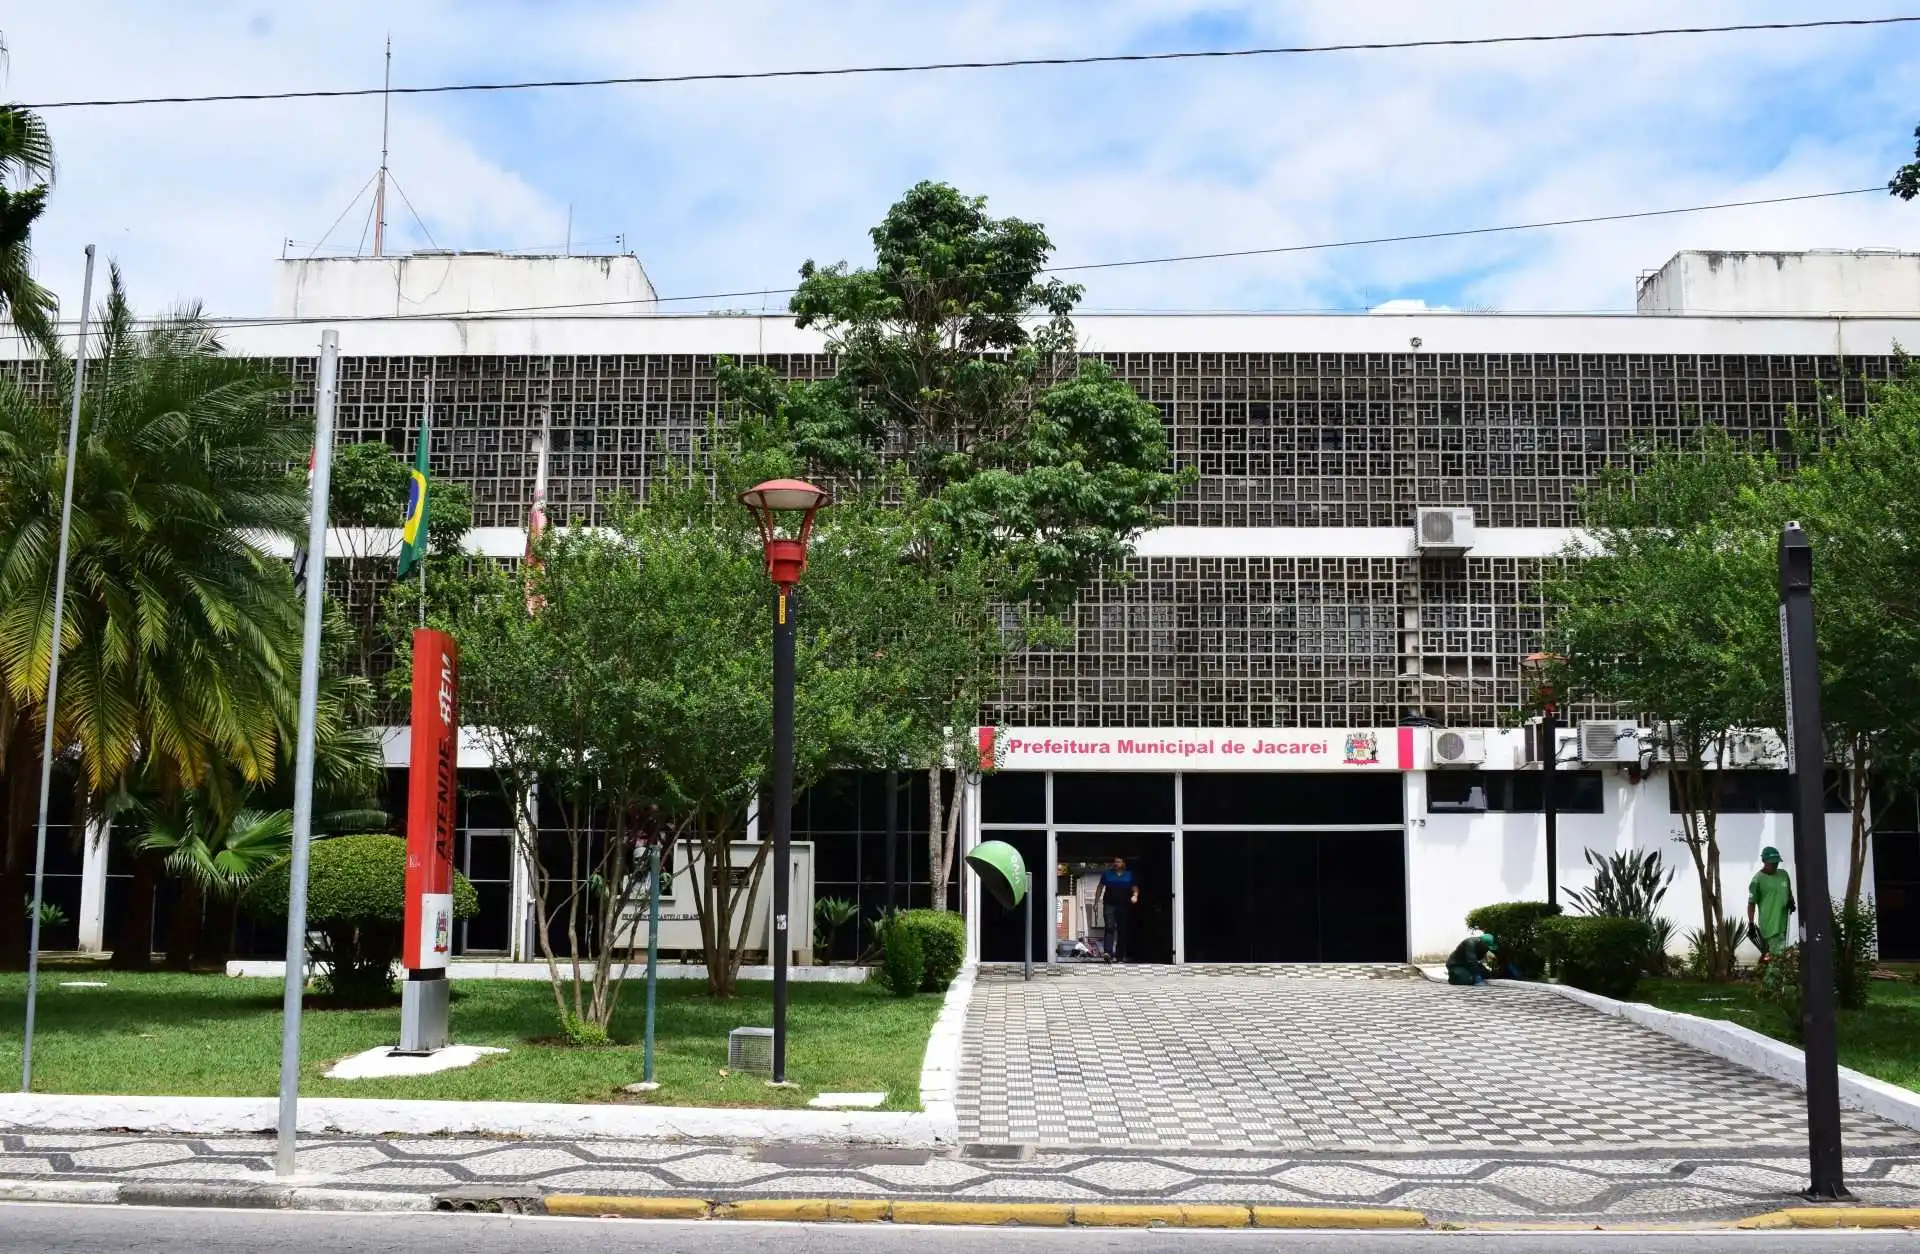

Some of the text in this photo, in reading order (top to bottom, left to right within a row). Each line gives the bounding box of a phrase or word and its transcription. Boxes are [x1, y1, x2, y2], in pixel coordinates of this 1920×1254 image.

[438, 652, 453, 727] BEM
[1009, 739, 1328, 757] Prefeitura Municipal de Jacarei
[436, 737, 450, 860] ATENDE
